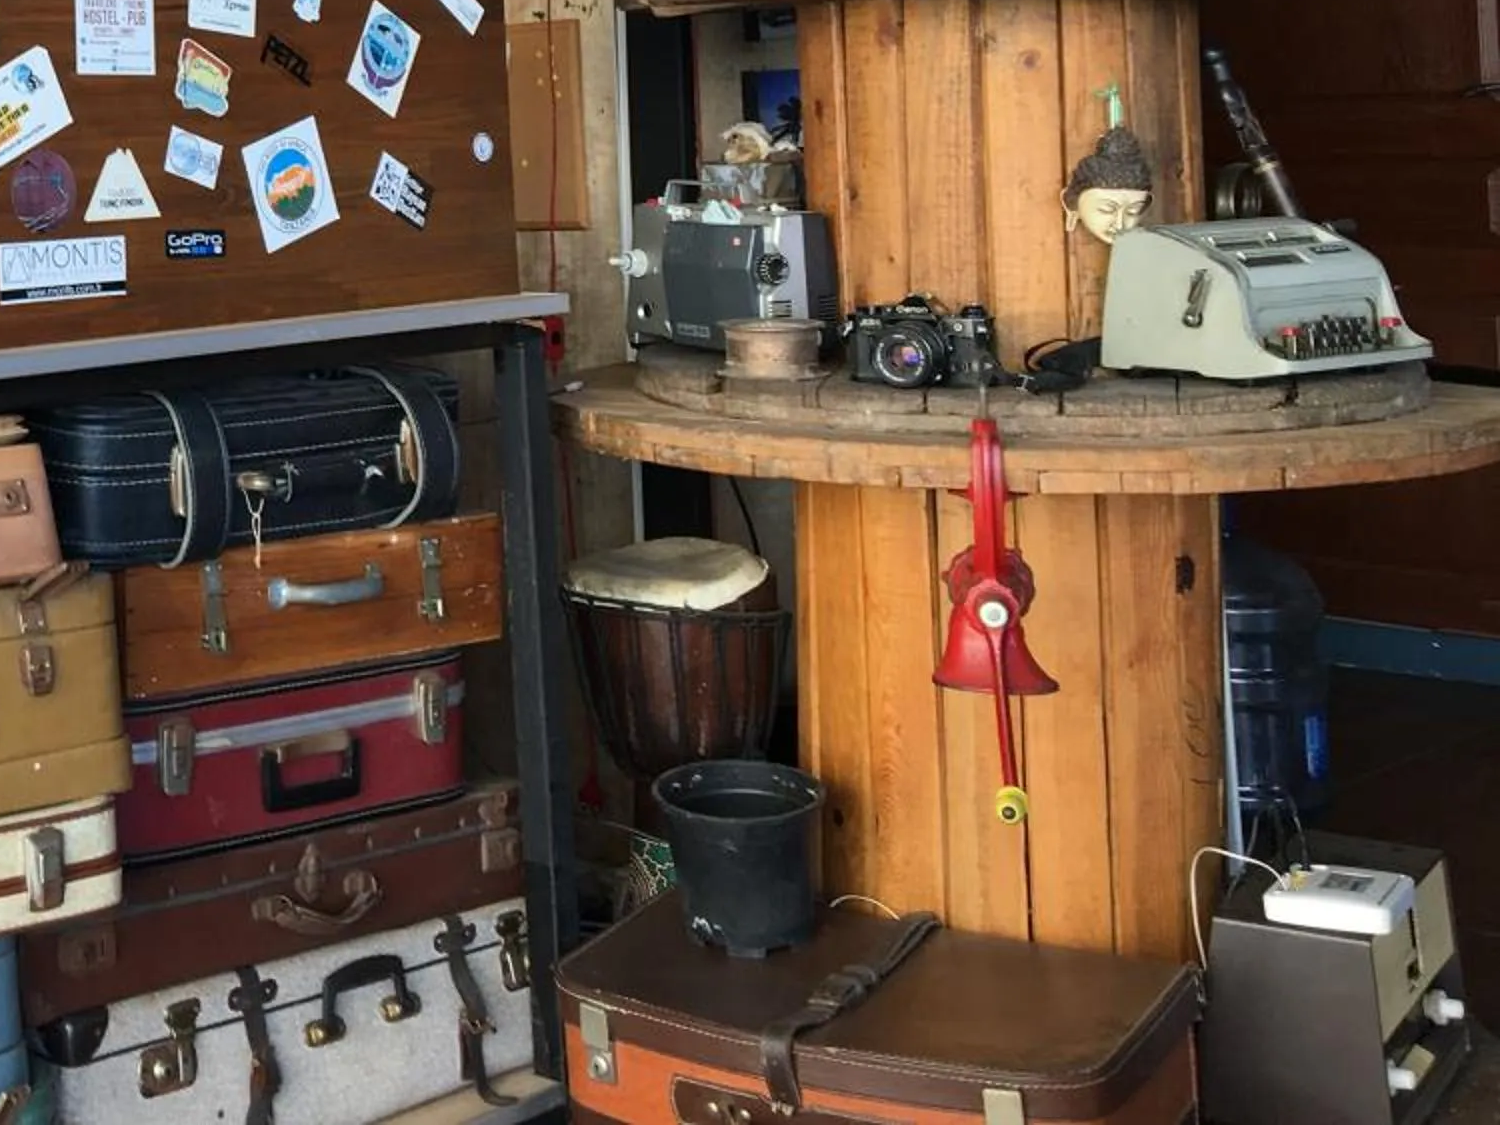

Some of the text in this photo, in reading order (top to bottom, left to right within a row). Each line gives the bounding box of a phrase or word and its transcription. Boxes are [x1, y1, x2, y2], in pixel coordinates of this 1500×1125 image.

[83, 11, 147, 26] HOSTEL PUB
[260, 35, 312, 88] PETZL
[167, 233, 223, 246] GoPro
[31, 240, 122, 269] MONTIS
[896, 306, 929, 314] Canon
